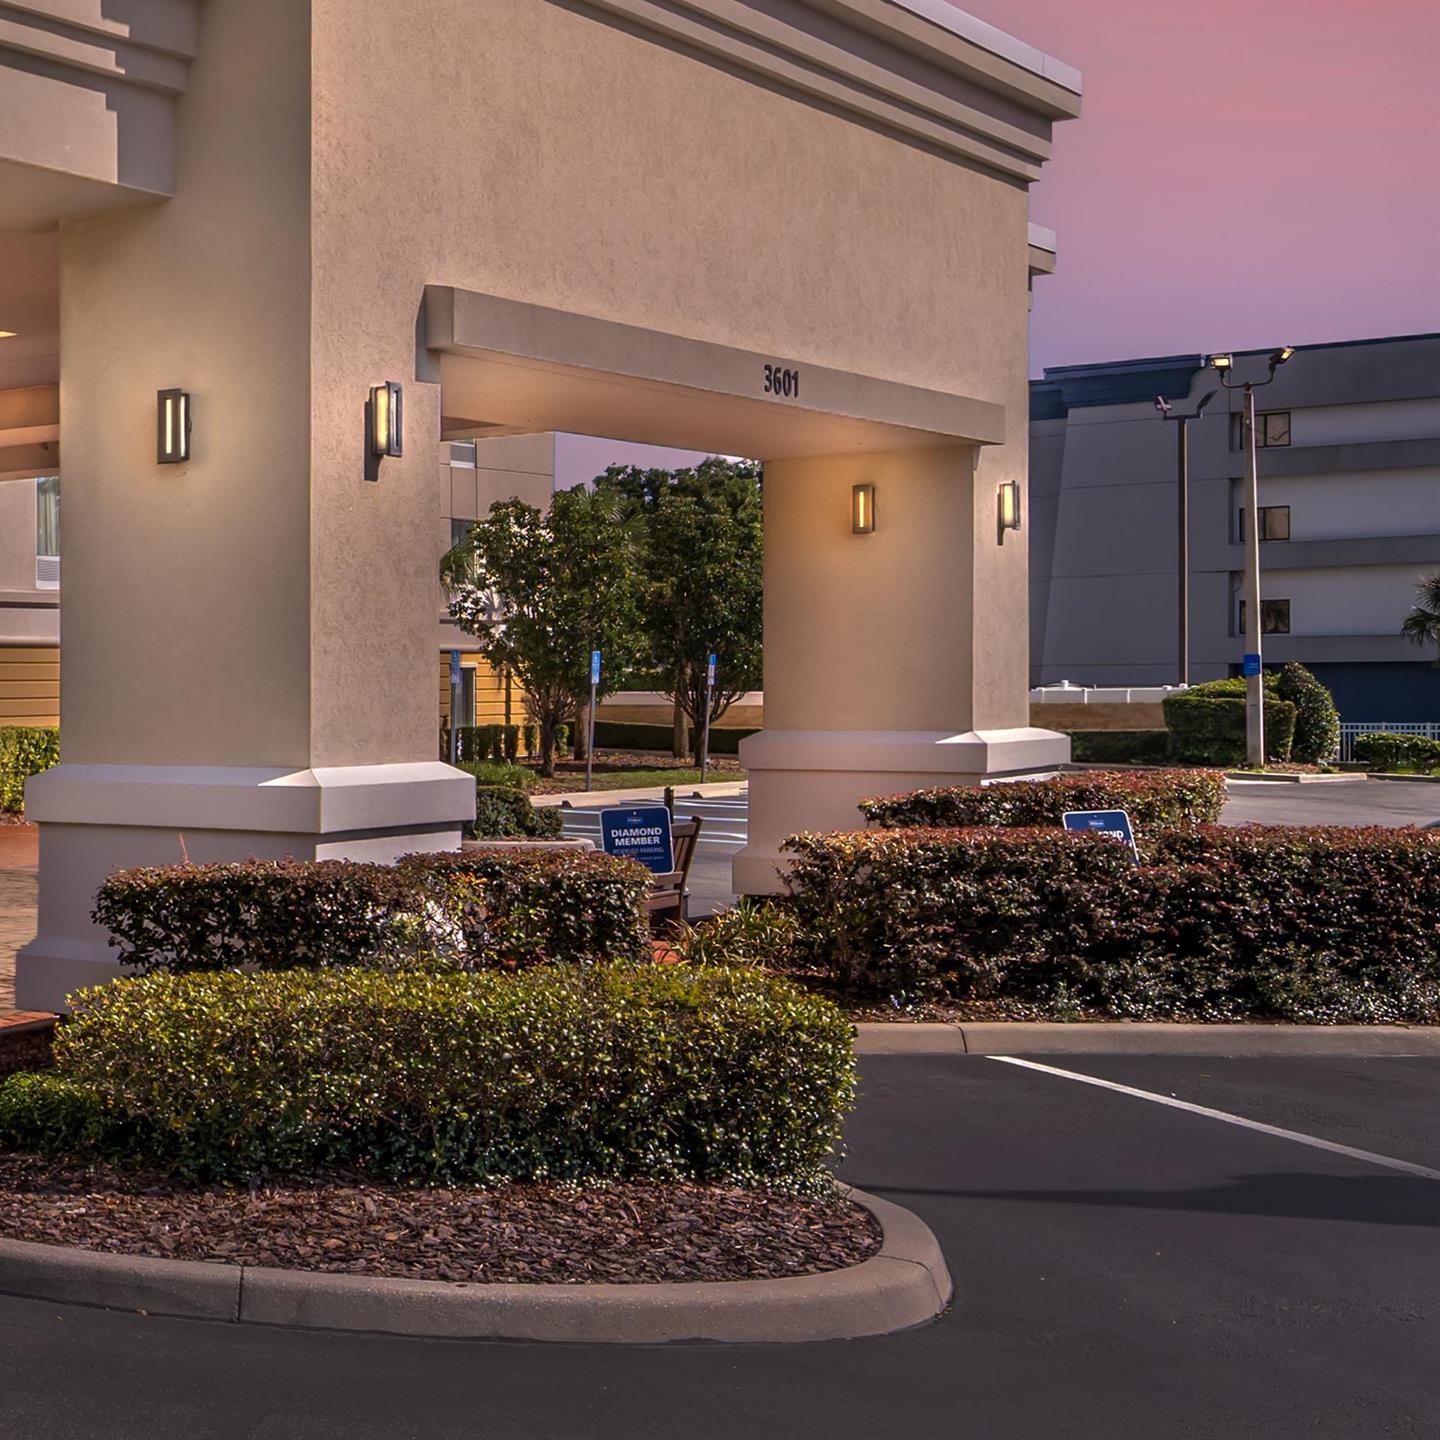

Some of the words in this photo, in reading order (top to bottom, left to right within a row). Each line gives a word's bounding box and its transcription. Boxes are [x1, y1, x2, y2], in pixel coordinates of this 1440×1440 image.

[764, 364, 799, 398] 3601
[611, 827, 662, 838] DIAMOND
[615, 836, 660, 846] MEMBER
